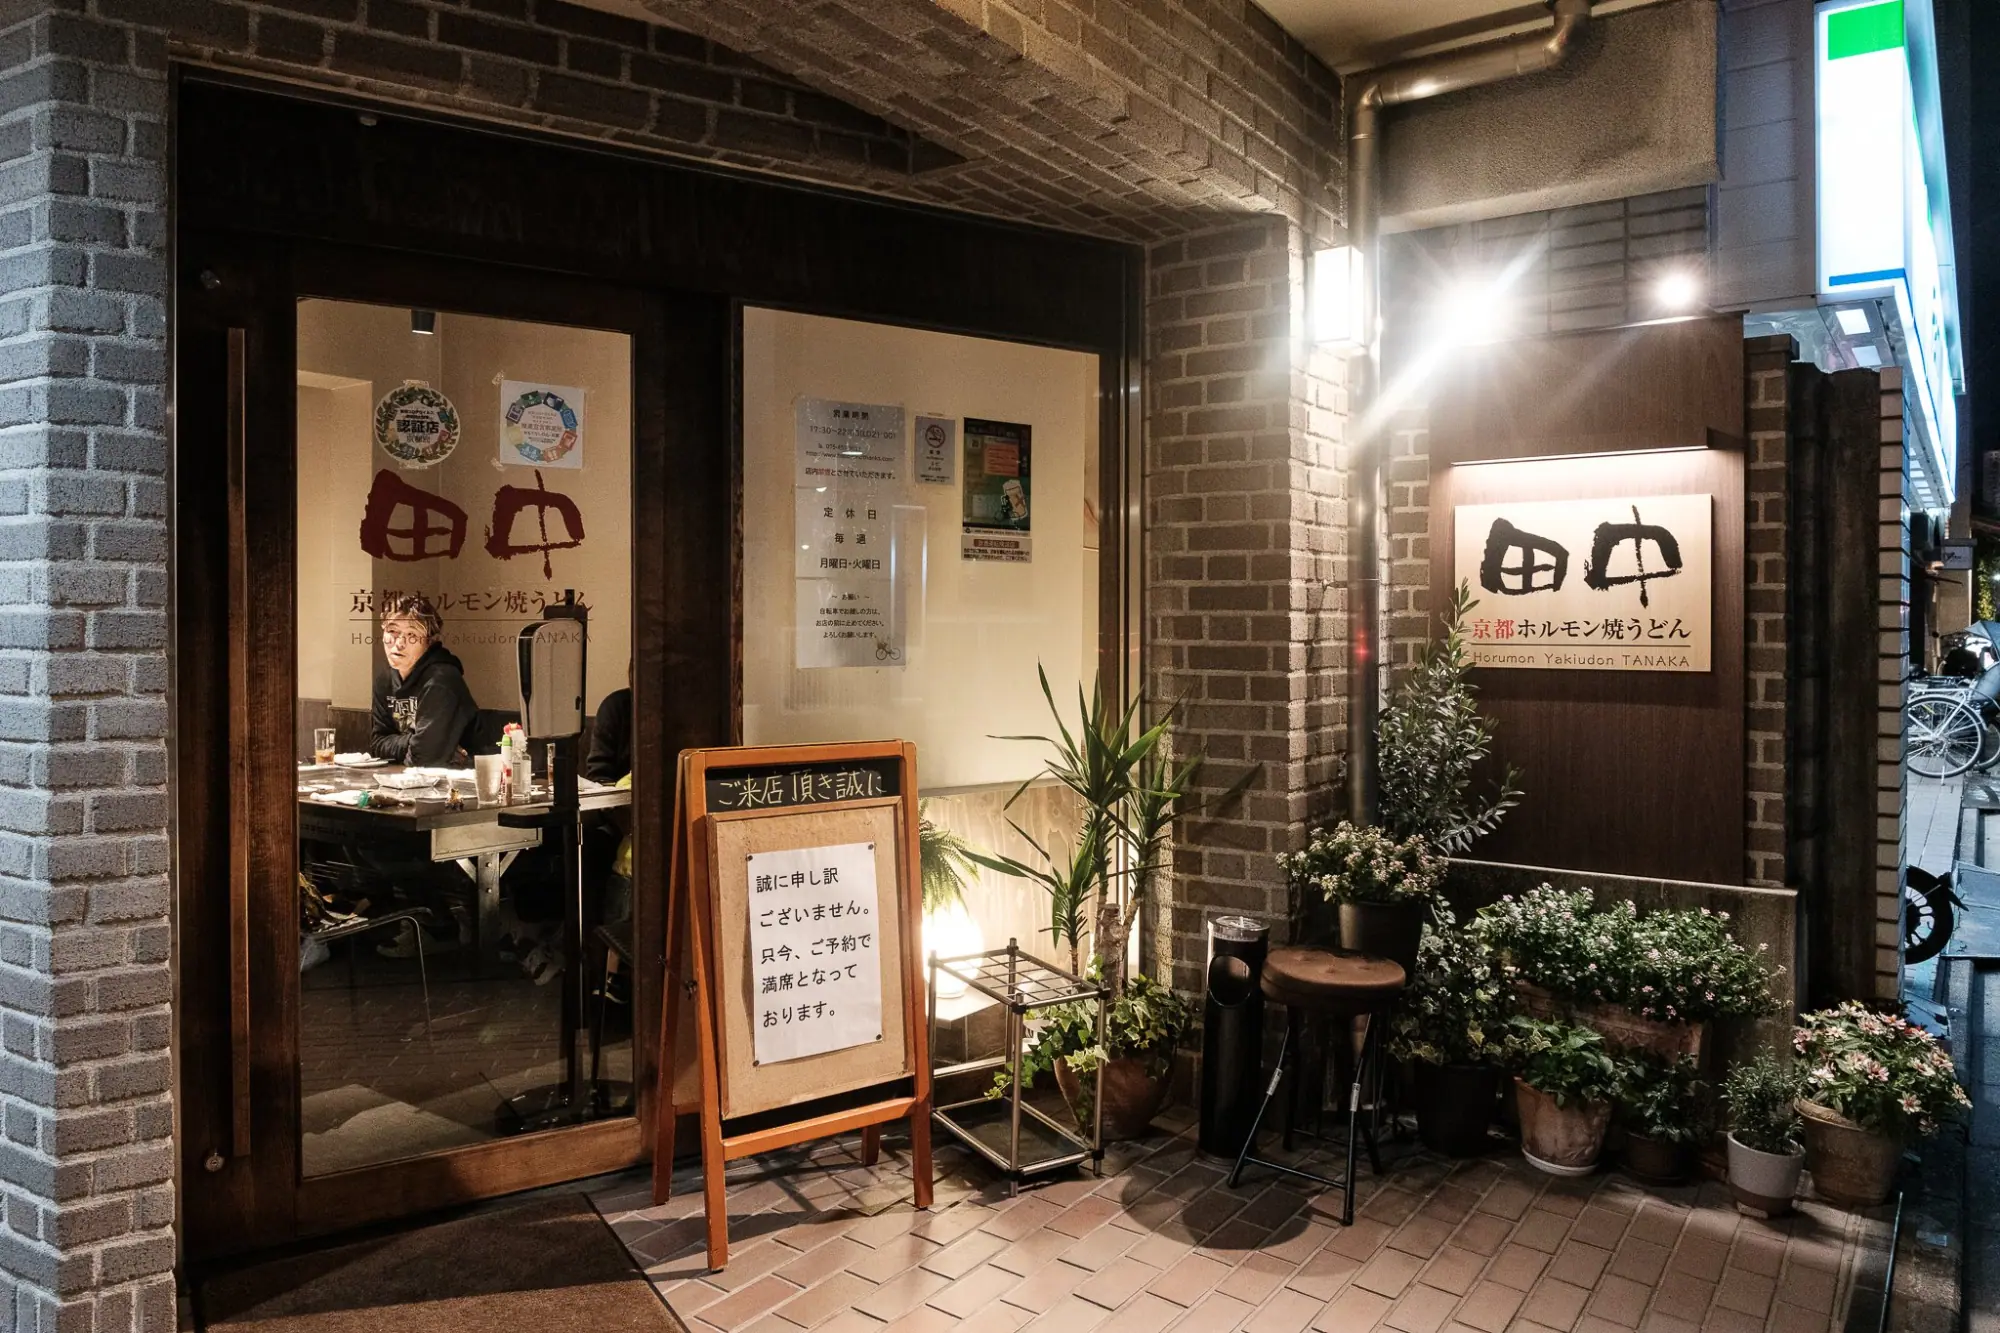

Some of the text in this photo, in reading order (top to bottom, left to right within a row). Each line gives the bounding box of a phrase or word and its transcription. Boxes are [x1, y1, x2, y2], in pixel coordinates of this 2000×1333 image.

[396, 419, 440, 434] 認証店
[359, 468, 585, 581] 田中
[819, 557, 881, 570] 月曜日・火曜日
[1480, 504, 1683, 609] 田中
[1471, 618, 1692, 640] 京都ホルモン焼うどん
[1473, 651, 1690, 667] Horumon Yakiudon TANAKA
[756, 867, 839, 893] 誠に申し訳
[760, 900, 870, 928] ございません。
[760, 933, 871, 965] 只今、ご予約で
[761, 963, 858, 994] 満席となって
[762, 1000, 836, 1028] おります。
